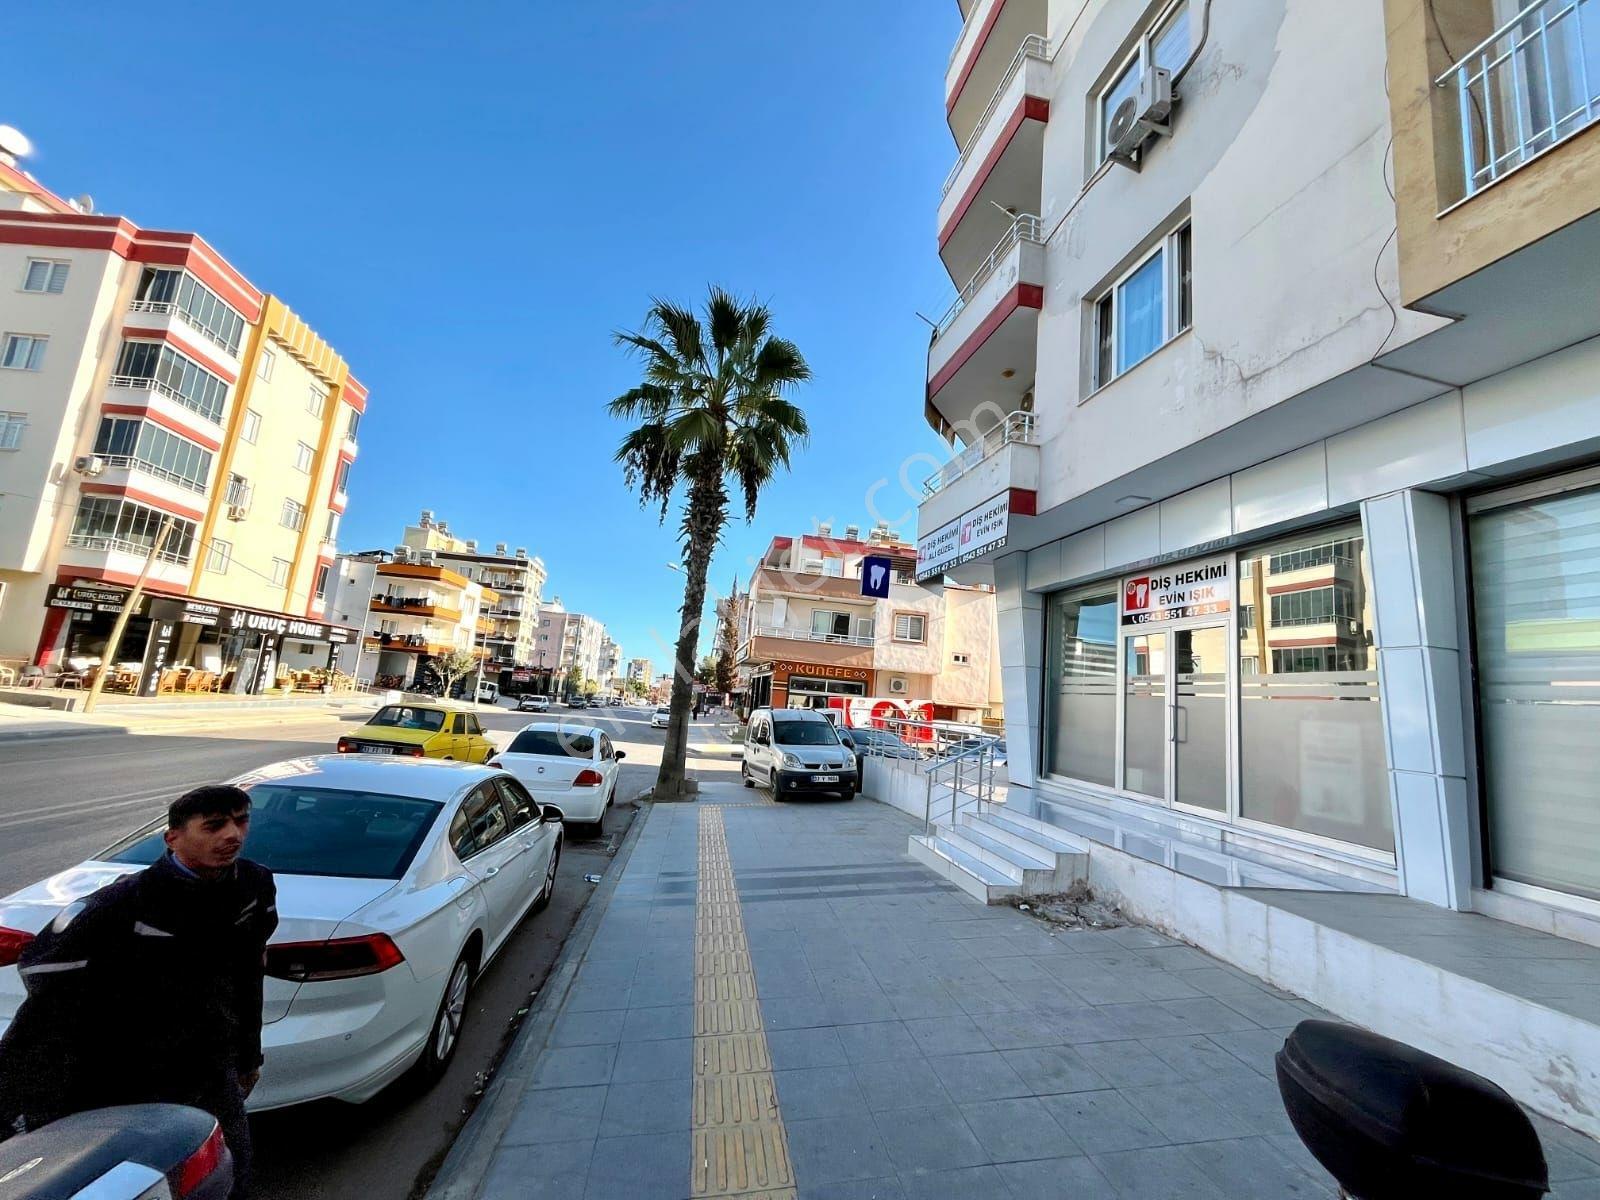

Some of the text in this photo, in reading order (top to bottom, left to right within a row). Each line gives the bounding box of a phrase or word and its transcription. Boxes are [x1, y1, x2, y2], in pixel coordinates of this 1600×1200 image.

[984, 501, 1008, 519] HEKİMİ
[1150, 575, 1171, 592] DİŞ
[1175, 561, 1227, 587] HEKİMİ
[1159, 586, 1215, 606] EVİN IŞIK
[1164, 607, 1182, 620] 551
[1186, 605, 1199, 616] 47
[248, 615, 288, 635] URUÇ
[289, 620, 323, 637] HOME
[795, 664, 852, 678] KÜNEFE
